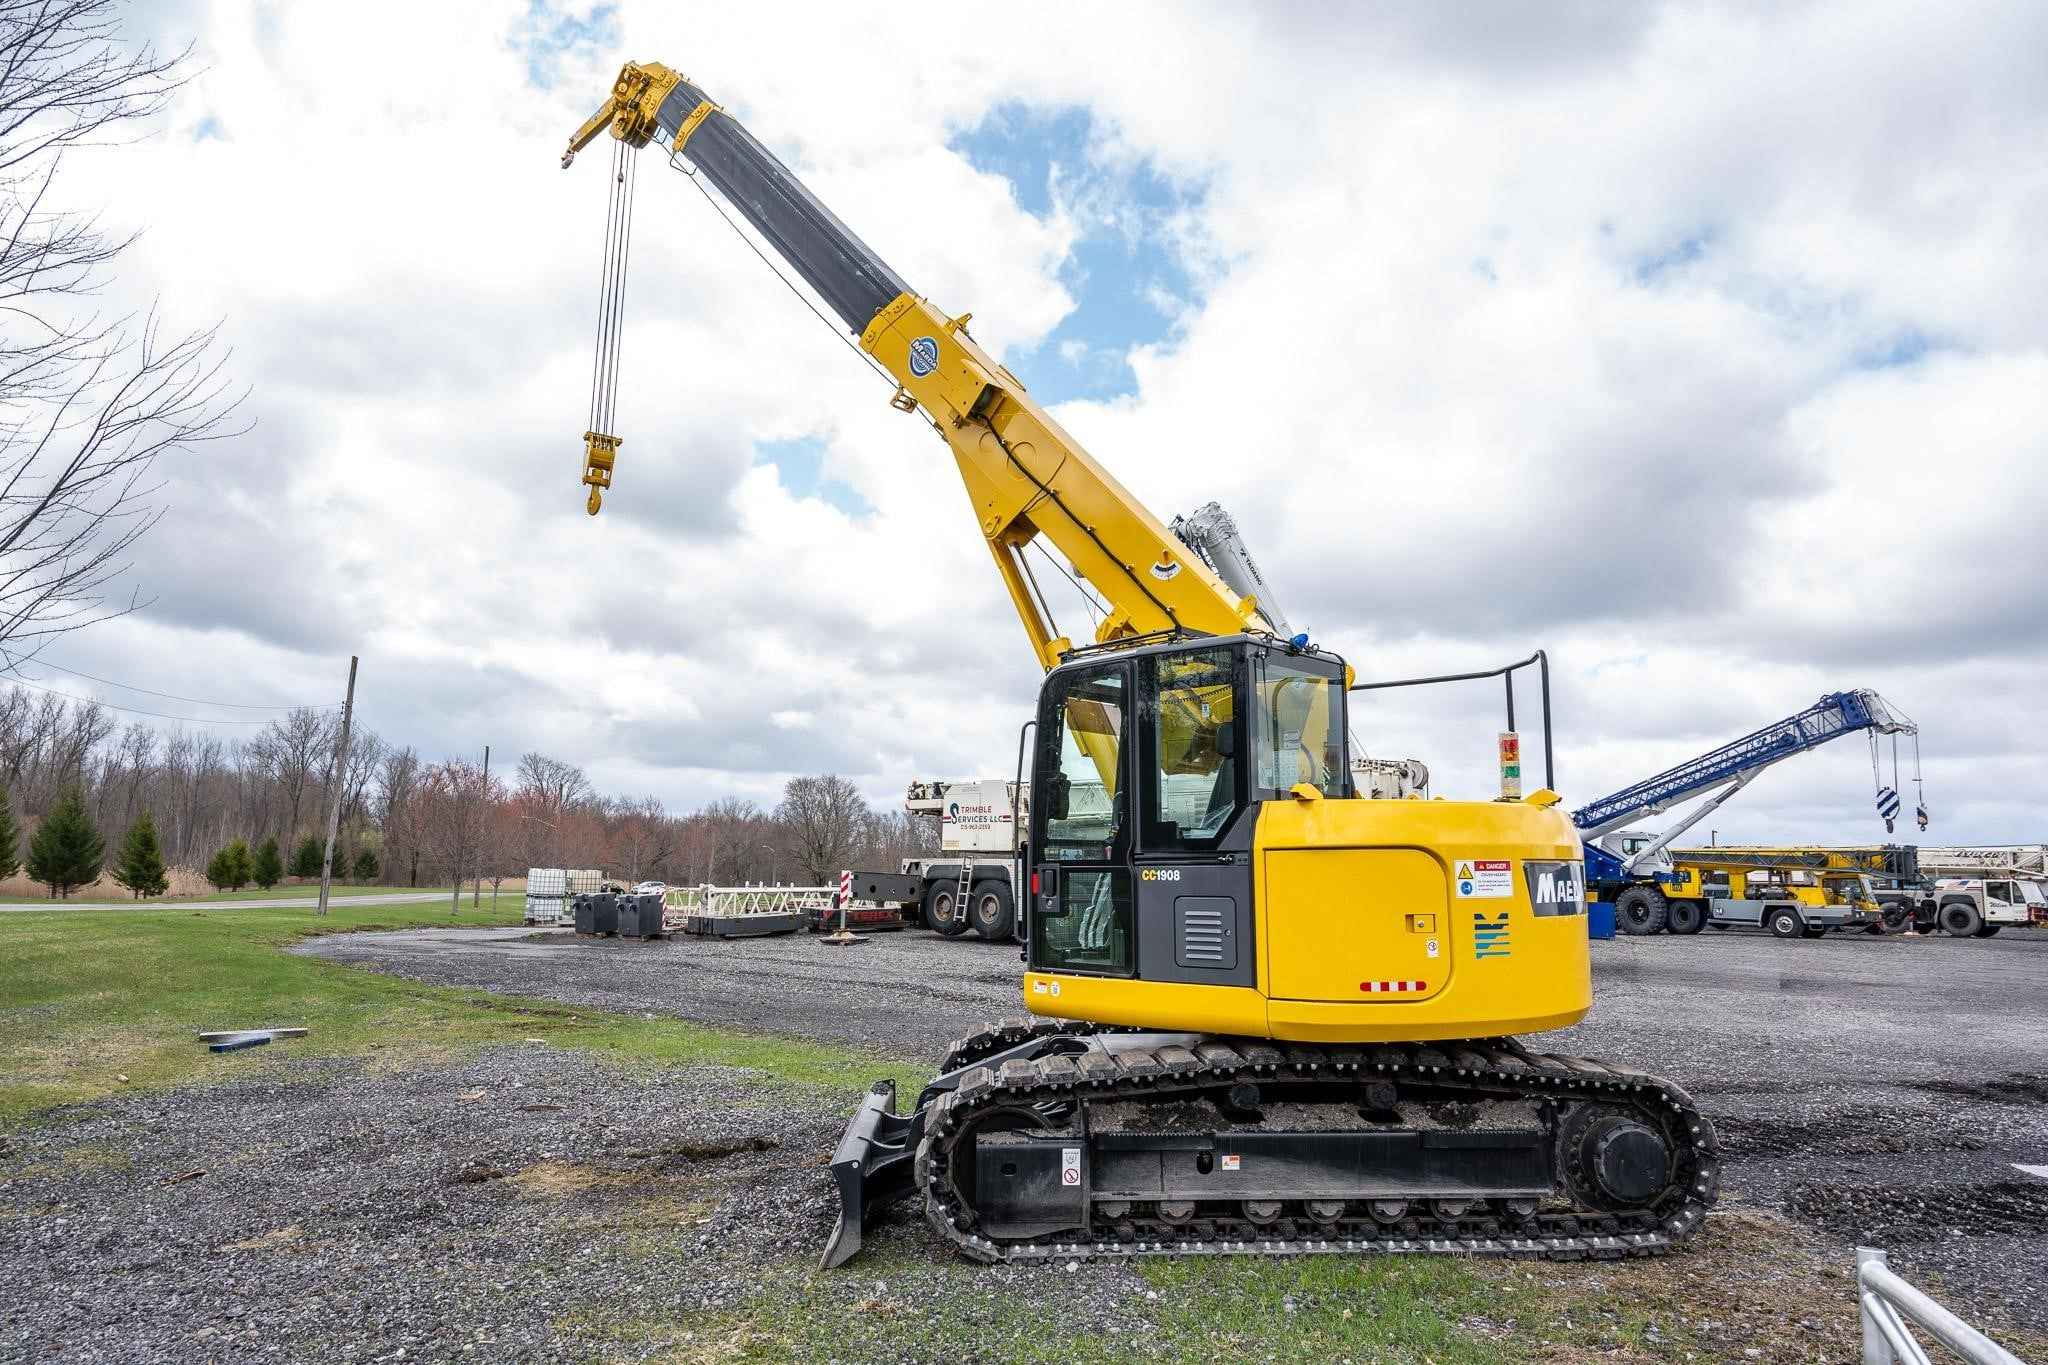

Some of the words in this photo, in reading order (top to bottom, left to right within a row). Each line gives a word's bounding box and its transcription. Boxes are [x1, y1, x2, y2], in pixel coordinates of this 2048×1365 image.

[1246, 558, 1263, 586] TADANO
[961, 805, 992, 814] TRIMBLE
[989, 815, 1002, 823] LLC
[1141, 869, 1181, 881] CC1908
